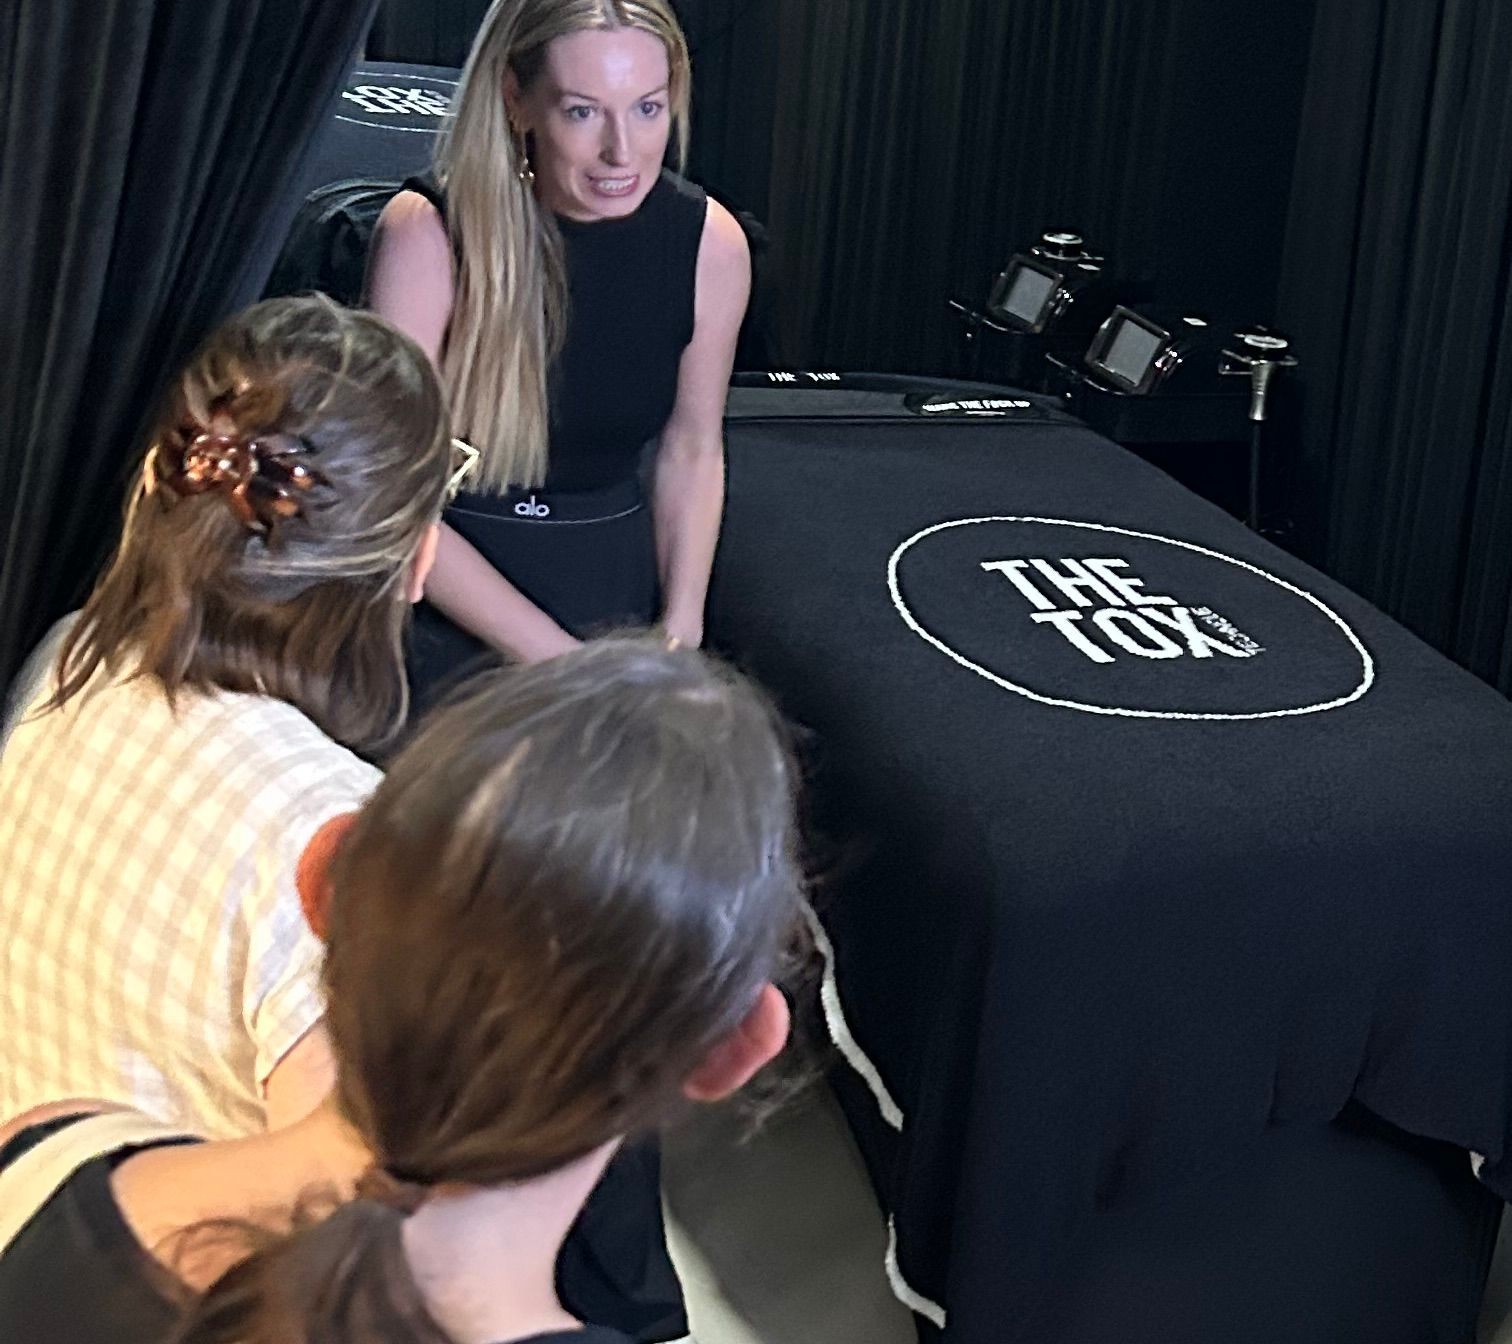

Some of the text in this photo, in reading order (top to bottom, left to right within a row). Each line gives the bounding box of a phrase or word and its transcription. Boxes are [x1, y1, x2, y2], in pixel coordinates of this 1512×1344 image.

[514, 495, 551, 517] alo
[980, 558, 1179, 611] THE
[1029, 606, 1259, 664] TOX
